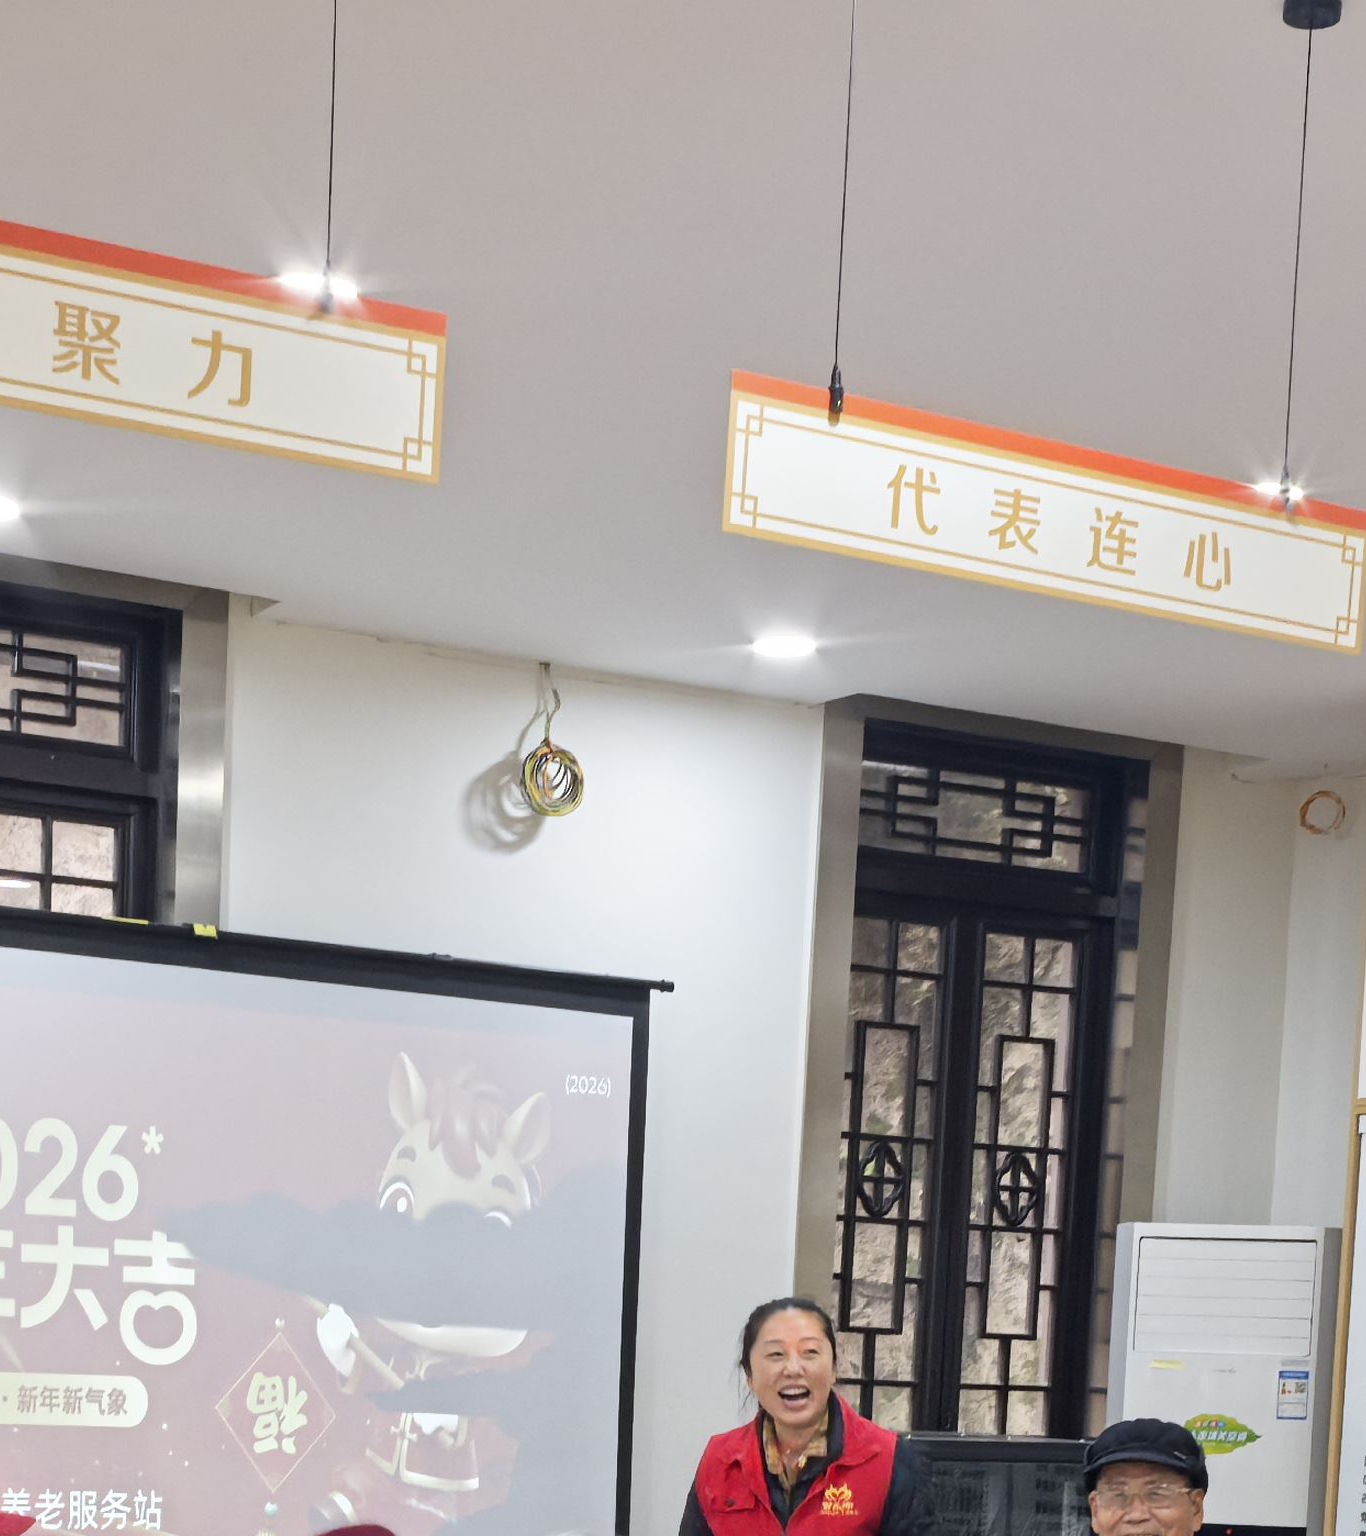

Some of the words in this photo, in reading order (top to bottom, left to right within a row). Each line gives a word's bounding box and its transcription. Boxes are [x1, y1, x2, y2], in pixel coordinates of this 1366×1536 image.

[886, 463, 1232, 592] 代表连心
[565, 1074, 611, 1099] (2026)
